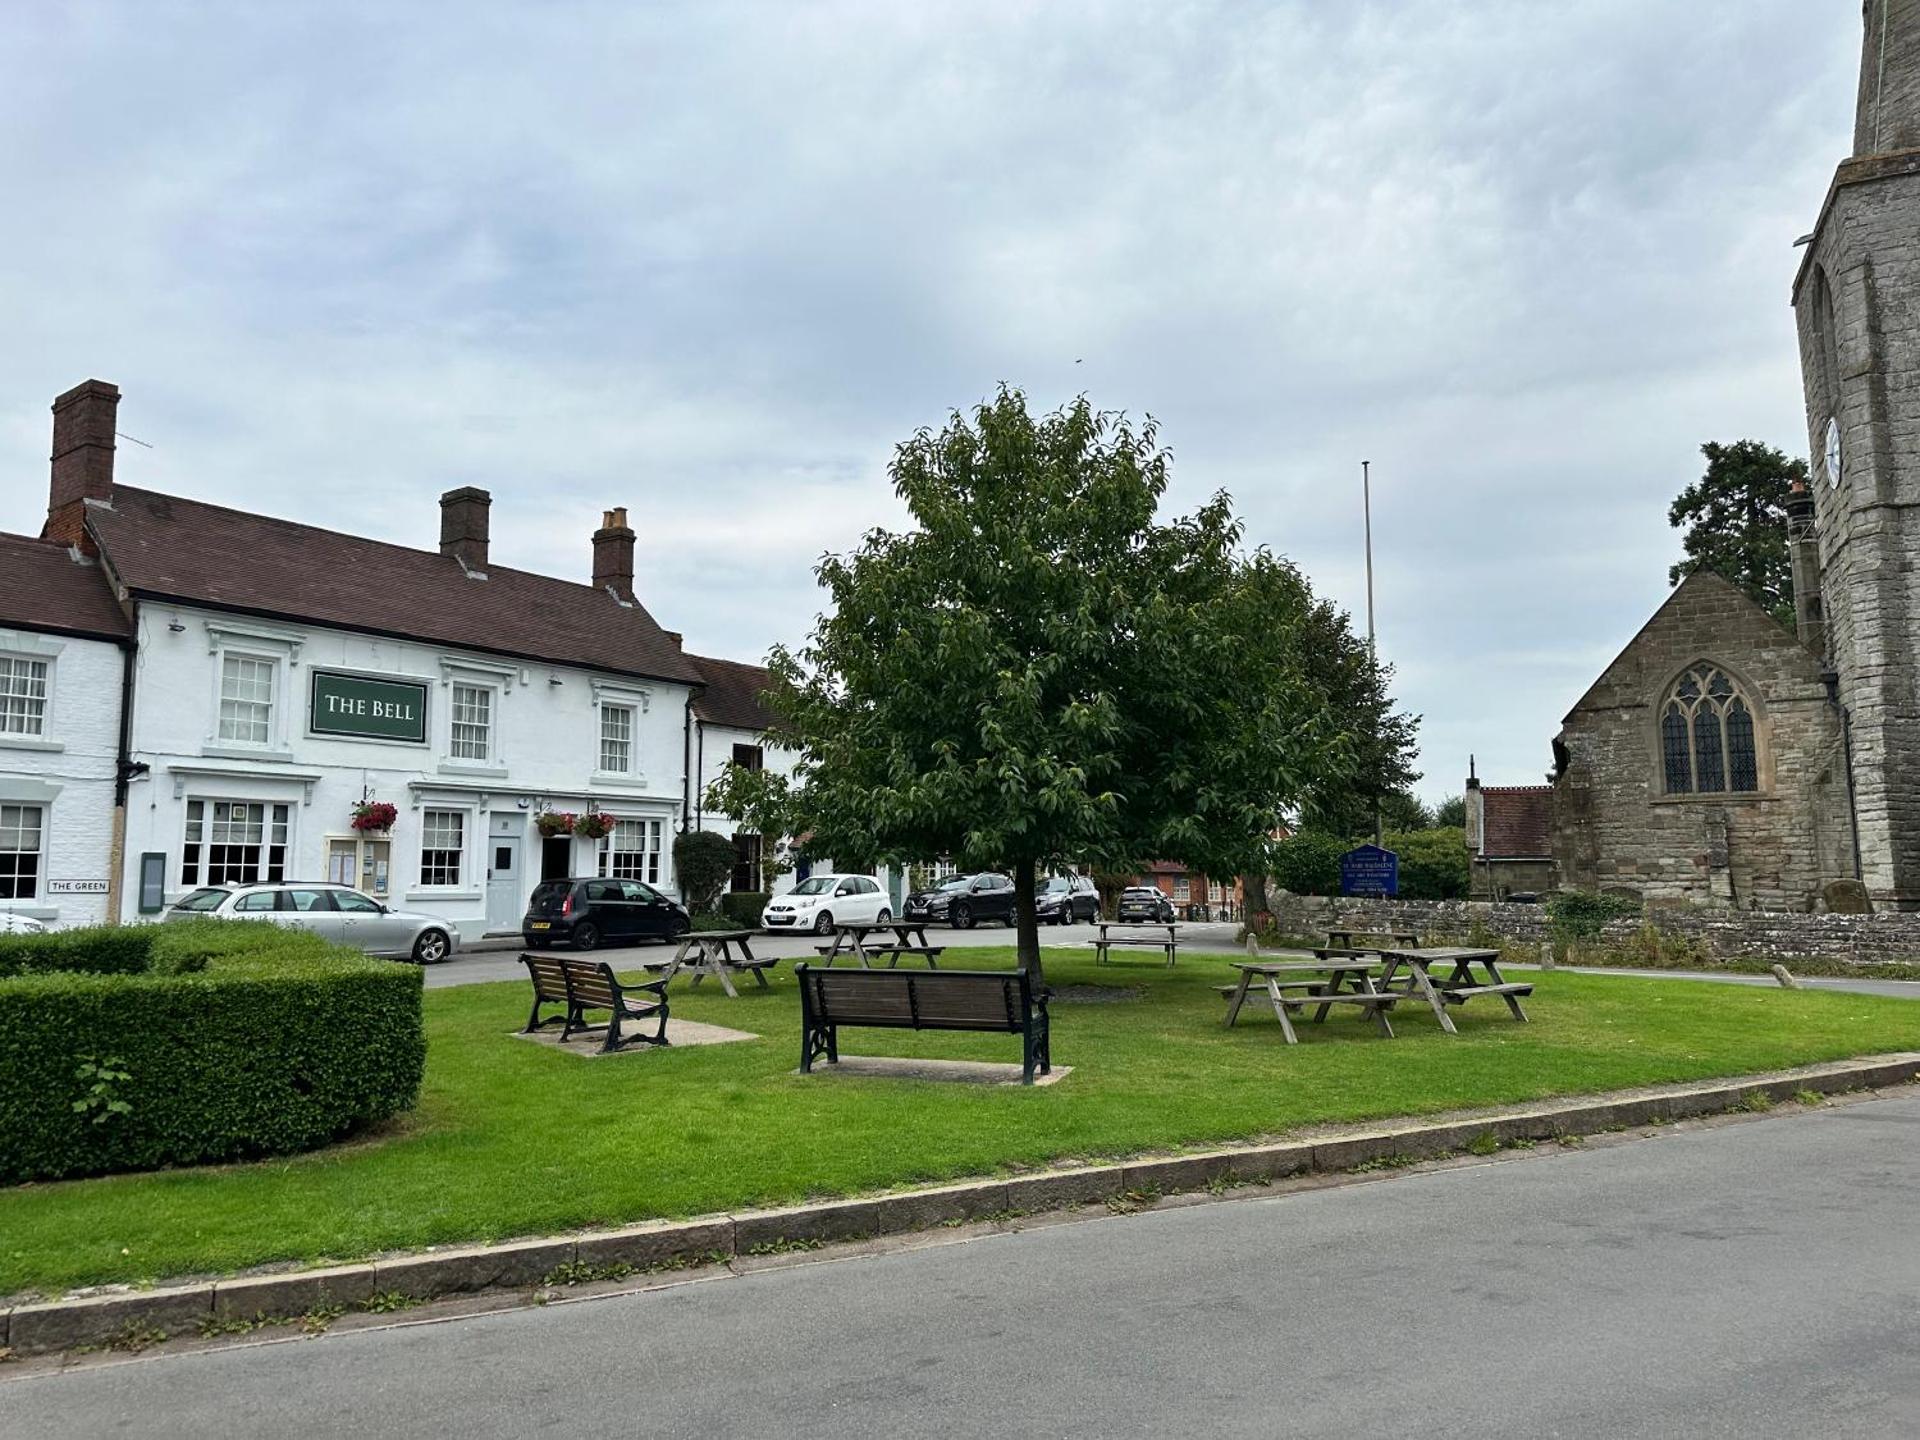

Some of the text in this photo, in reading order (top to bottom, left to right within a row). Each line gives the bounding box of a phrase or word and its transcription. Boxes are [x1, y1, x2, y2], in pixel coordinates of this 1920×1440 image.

[325, 694, 414, 720] THE BELL
[52, 882, 106, 890] THE GREEN
